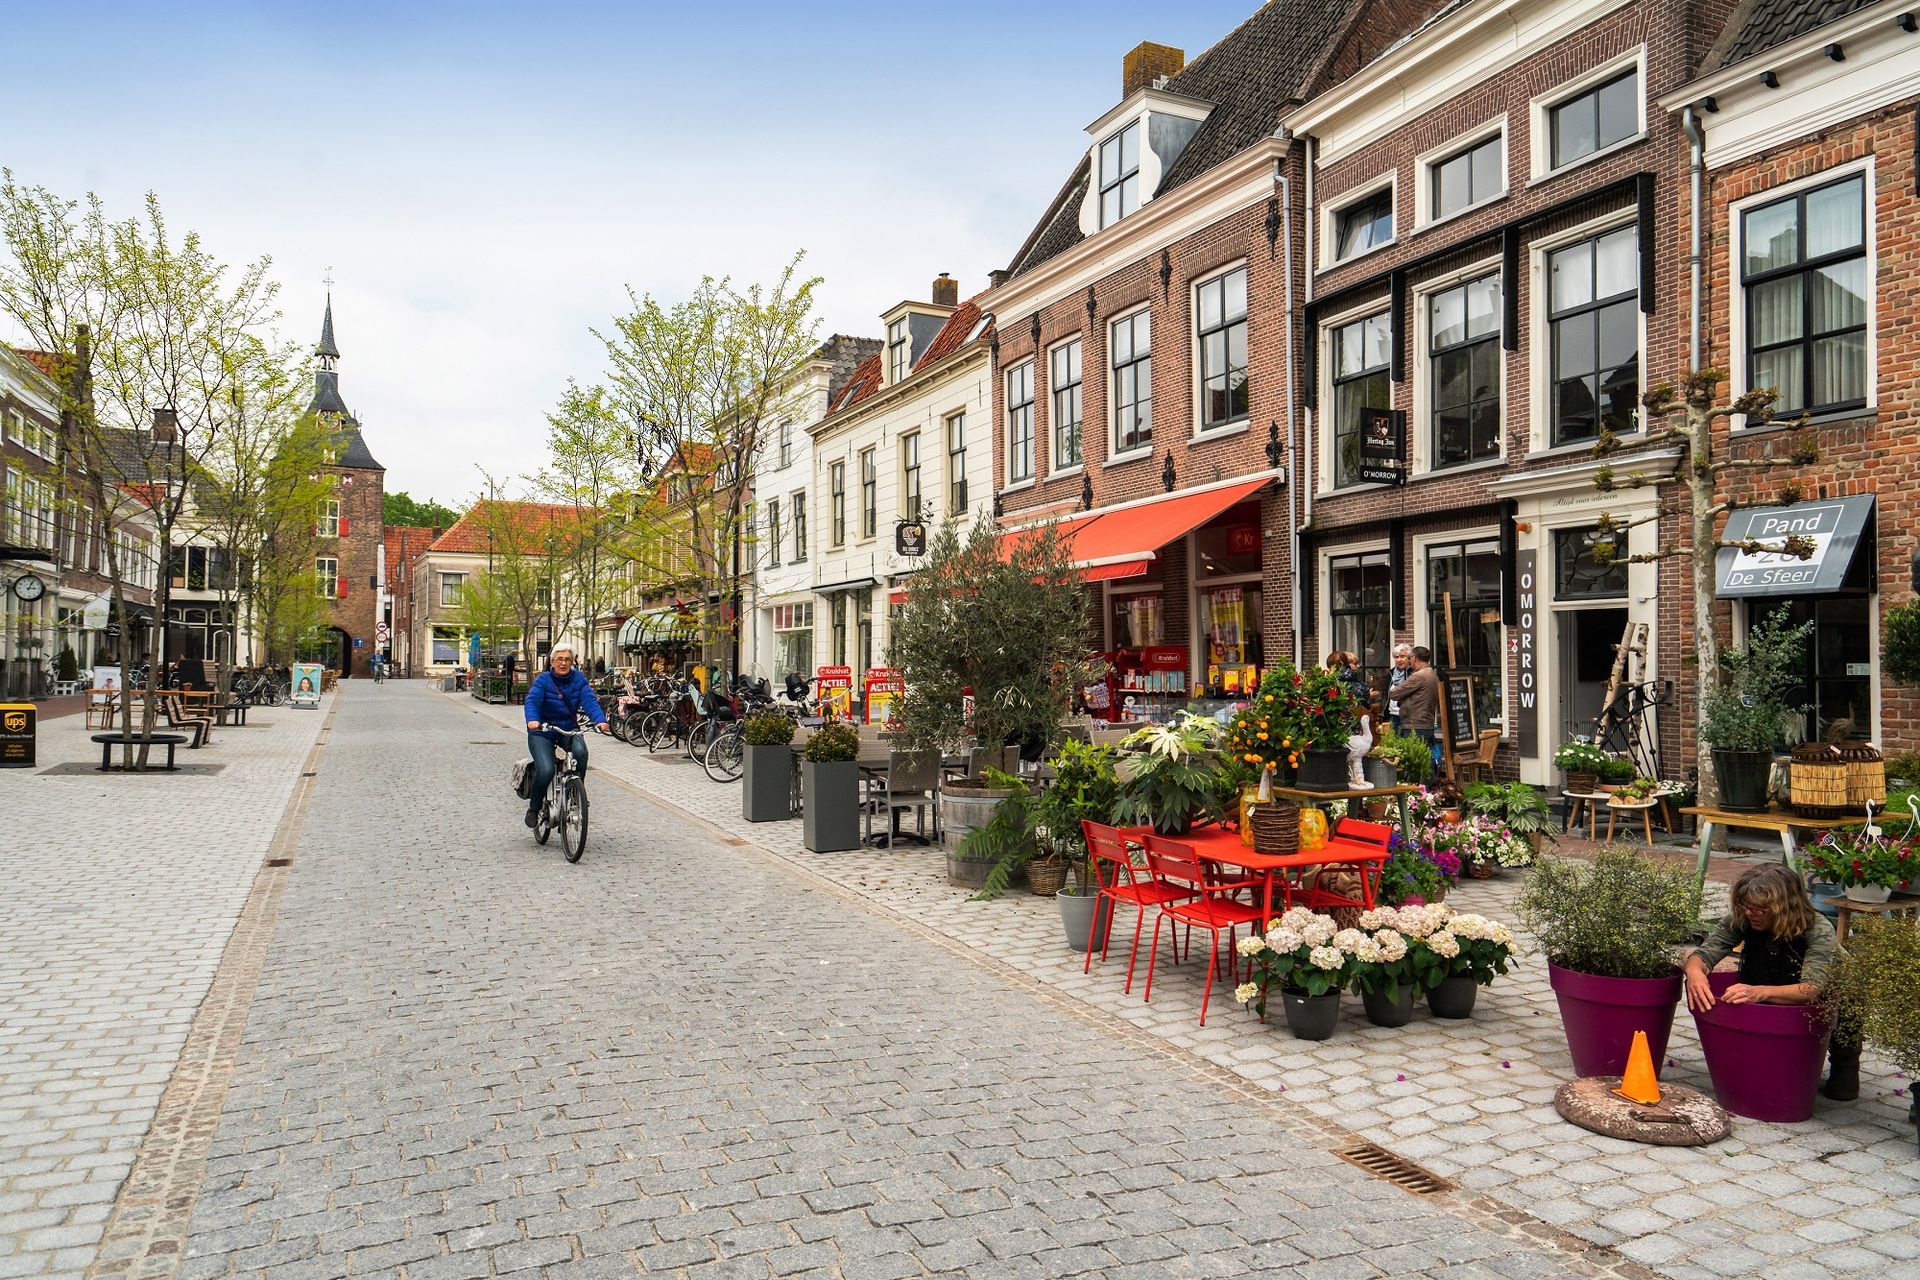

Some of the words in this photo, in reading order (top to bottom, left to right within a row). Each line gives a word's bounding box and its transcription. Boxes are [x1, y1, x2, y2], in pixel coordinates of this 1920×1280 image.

[1762, 512, 1823, 535] Pand
[1729, 572, 1755, 586] De
[1760, 569, 1812, 584] Sfeer
[821, 678, 847, 688] ACTIE!
[6, 717, 25, 729] ups
